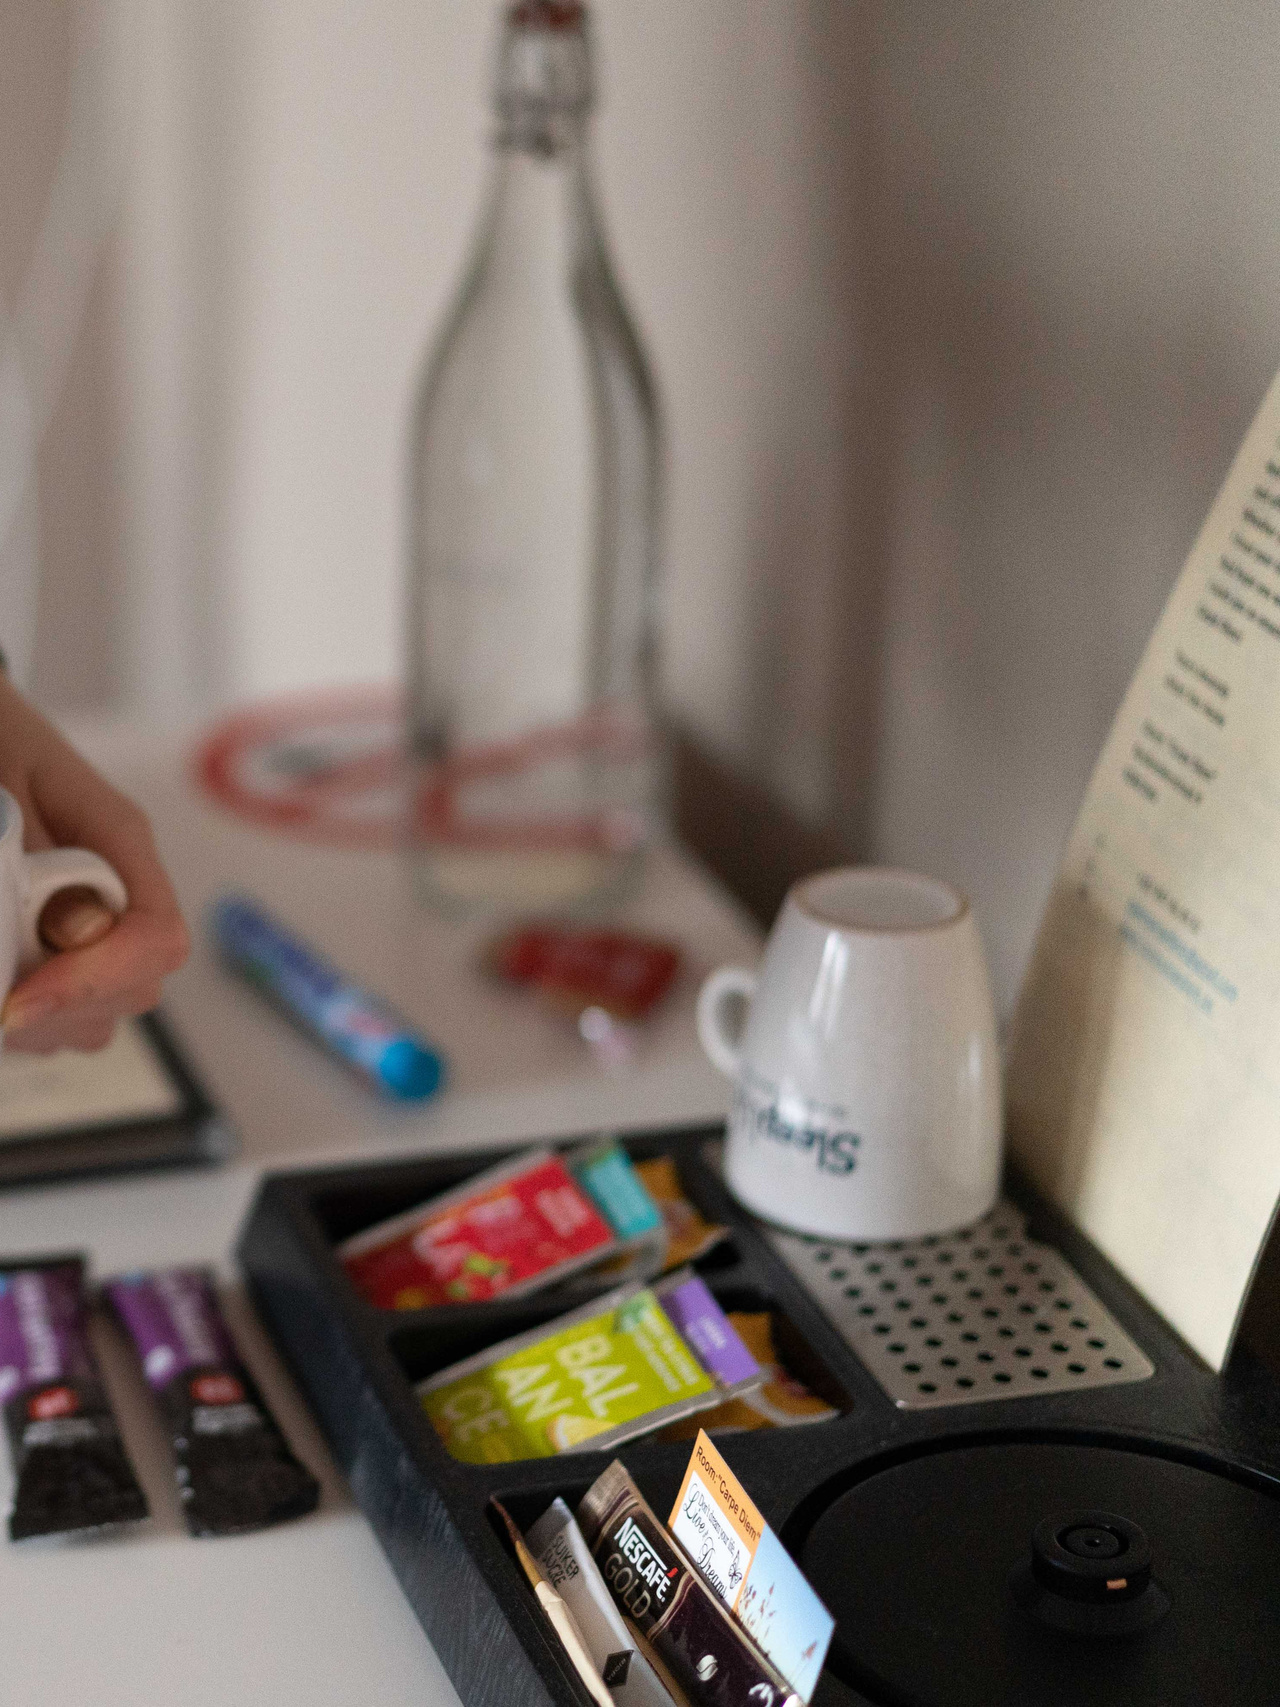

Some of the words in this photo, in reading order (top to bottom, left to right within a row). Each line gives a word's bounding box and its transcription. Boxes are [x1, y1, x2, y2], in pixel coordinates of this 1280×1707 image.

[493, 1363, 574, 1423] AN
[555, 1334, 640, 1418] BAL
[682, 1483, 705, 1533] Live
[553, 1535, 580, 1580] SUIKER
[605, 1553, 651, 1618] GOLD
